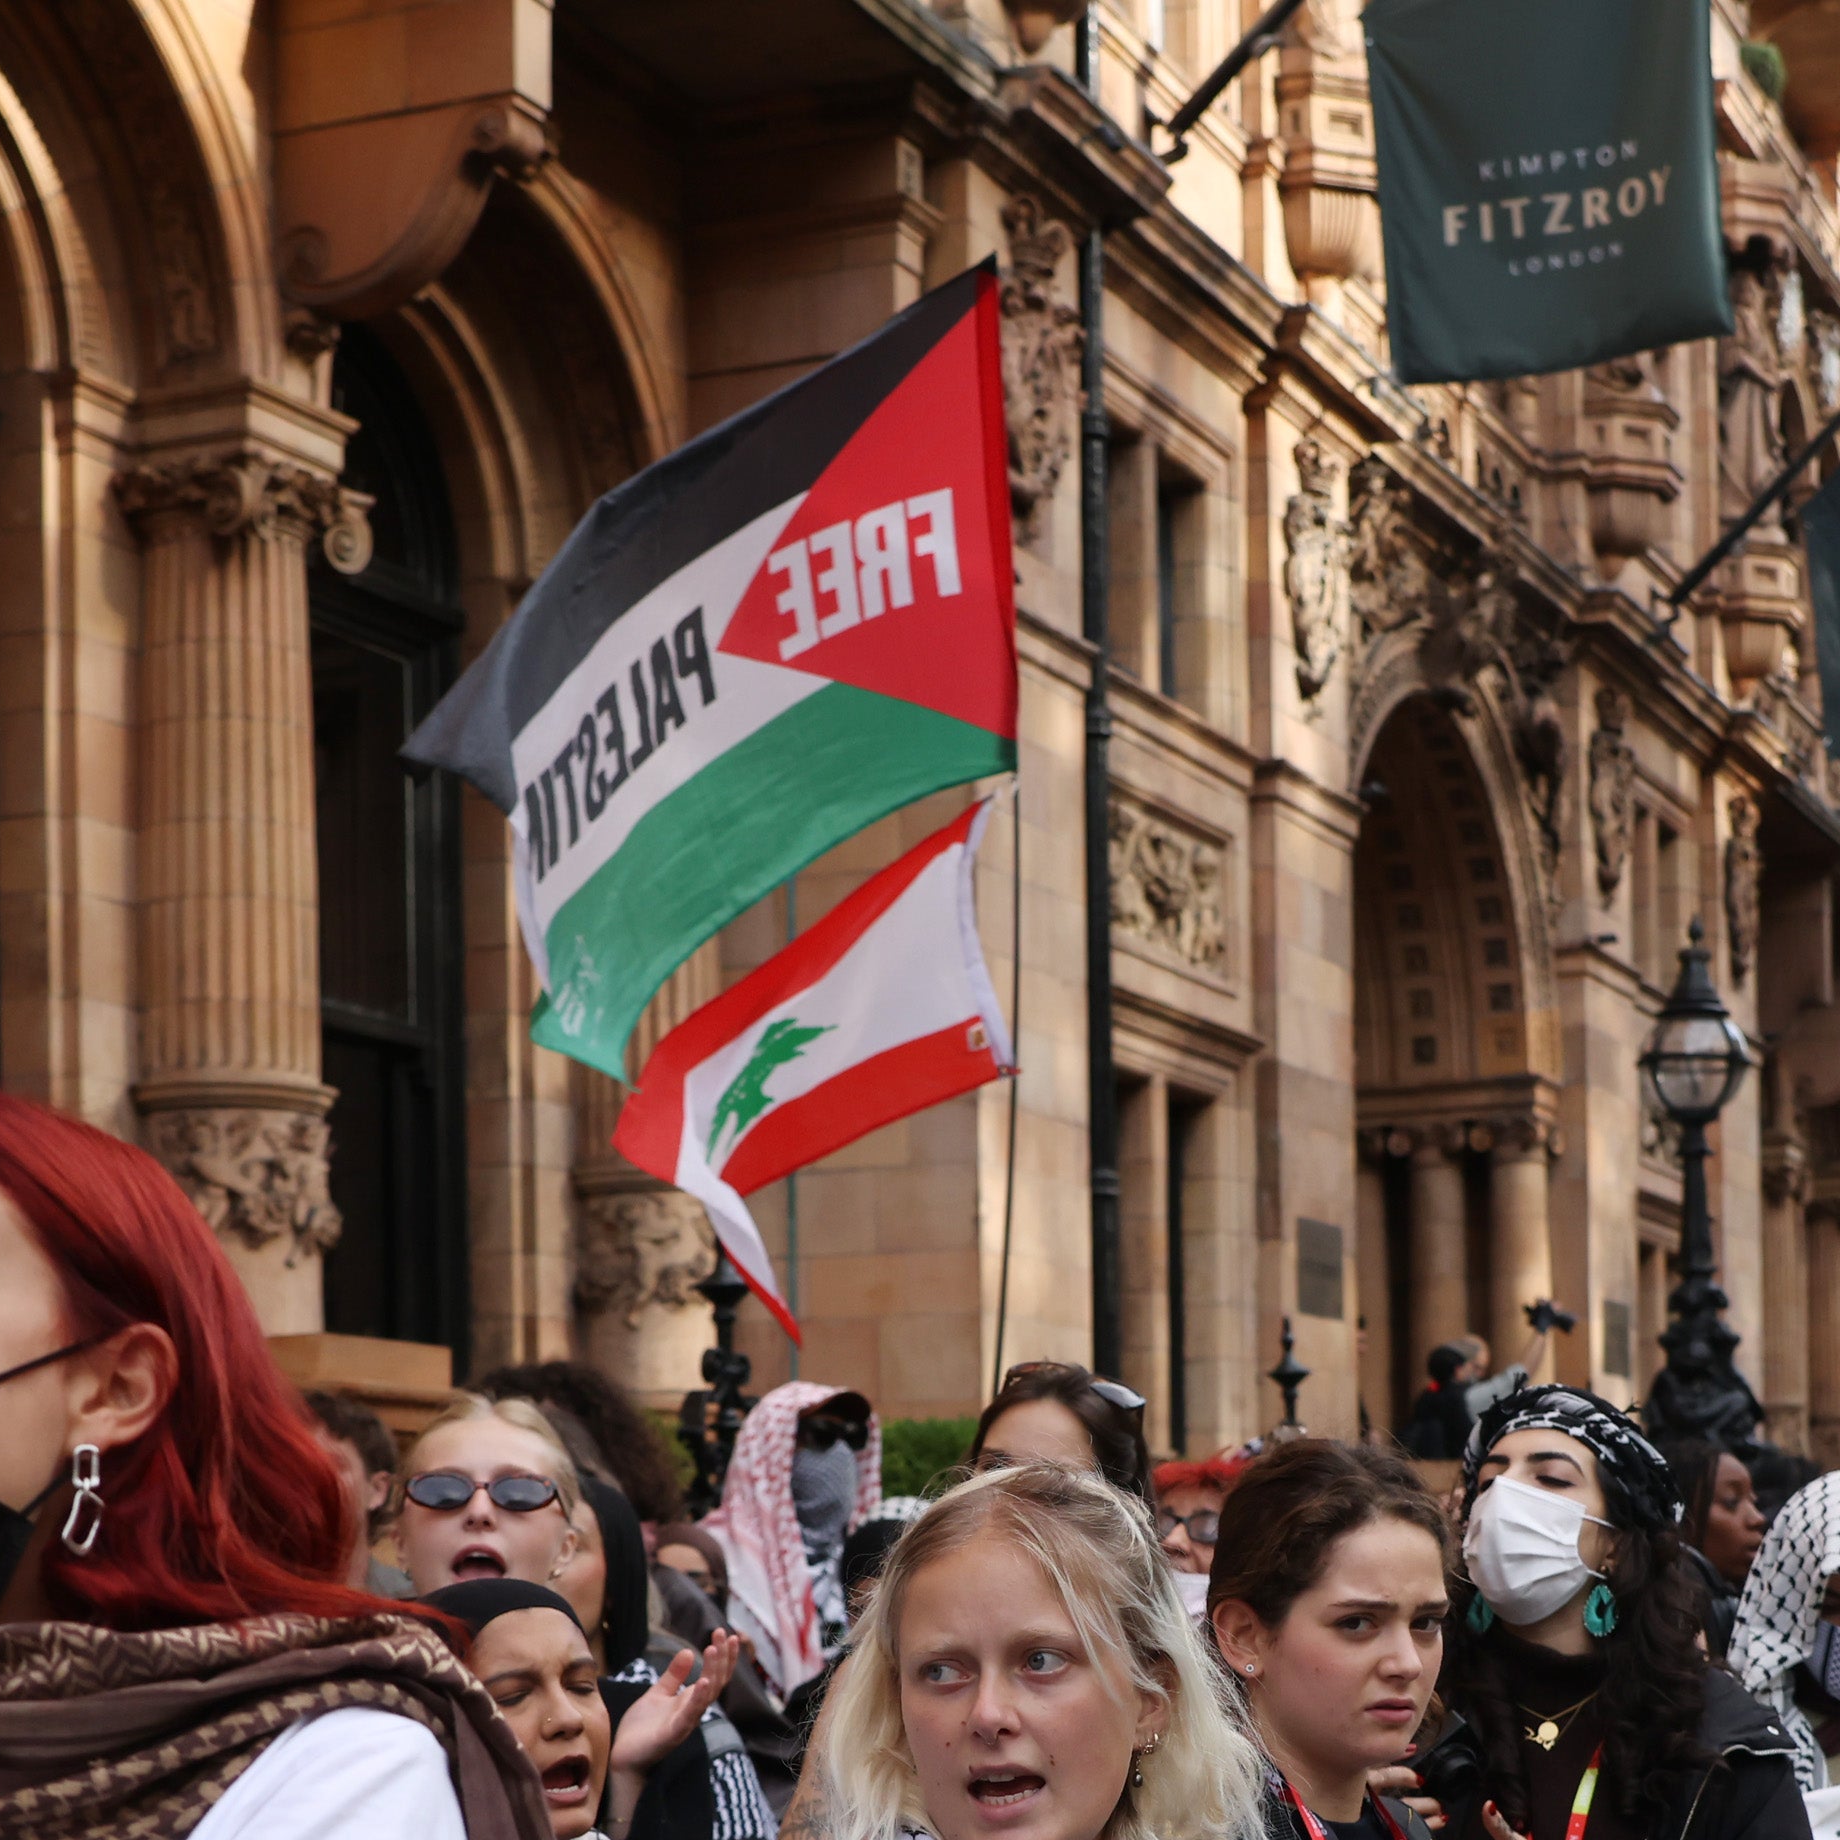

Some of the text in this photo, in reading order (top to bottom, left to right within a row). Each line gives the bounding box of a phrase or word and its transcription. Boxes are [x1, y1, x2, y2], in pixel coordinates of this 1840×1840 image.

[1478, 139, 1638, 181] KIMPTON
[1442, 165, 1672, 247] FITZROY
[1509, 242, 1624, 276] LONDON
